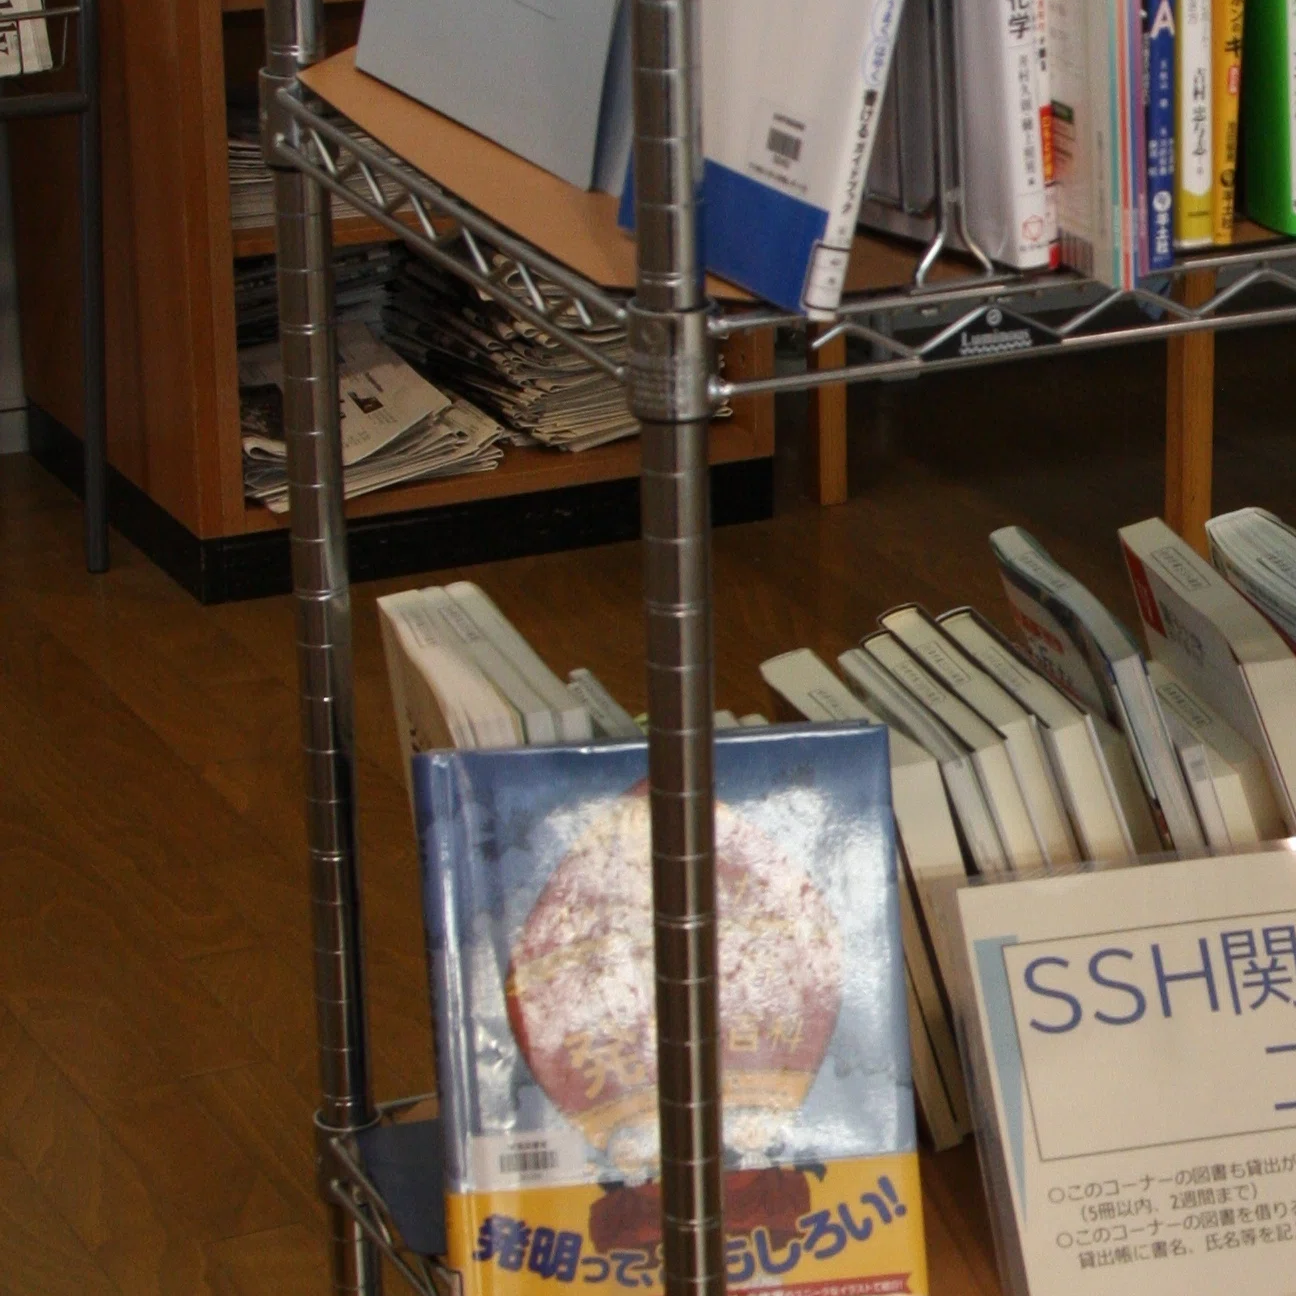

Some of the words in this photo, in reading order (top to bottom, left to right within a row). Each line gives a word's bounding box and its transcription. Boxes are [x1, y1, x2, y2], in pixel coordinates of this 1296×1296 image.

[472, 1175, 908, 1287] 発明って、もしろい!
